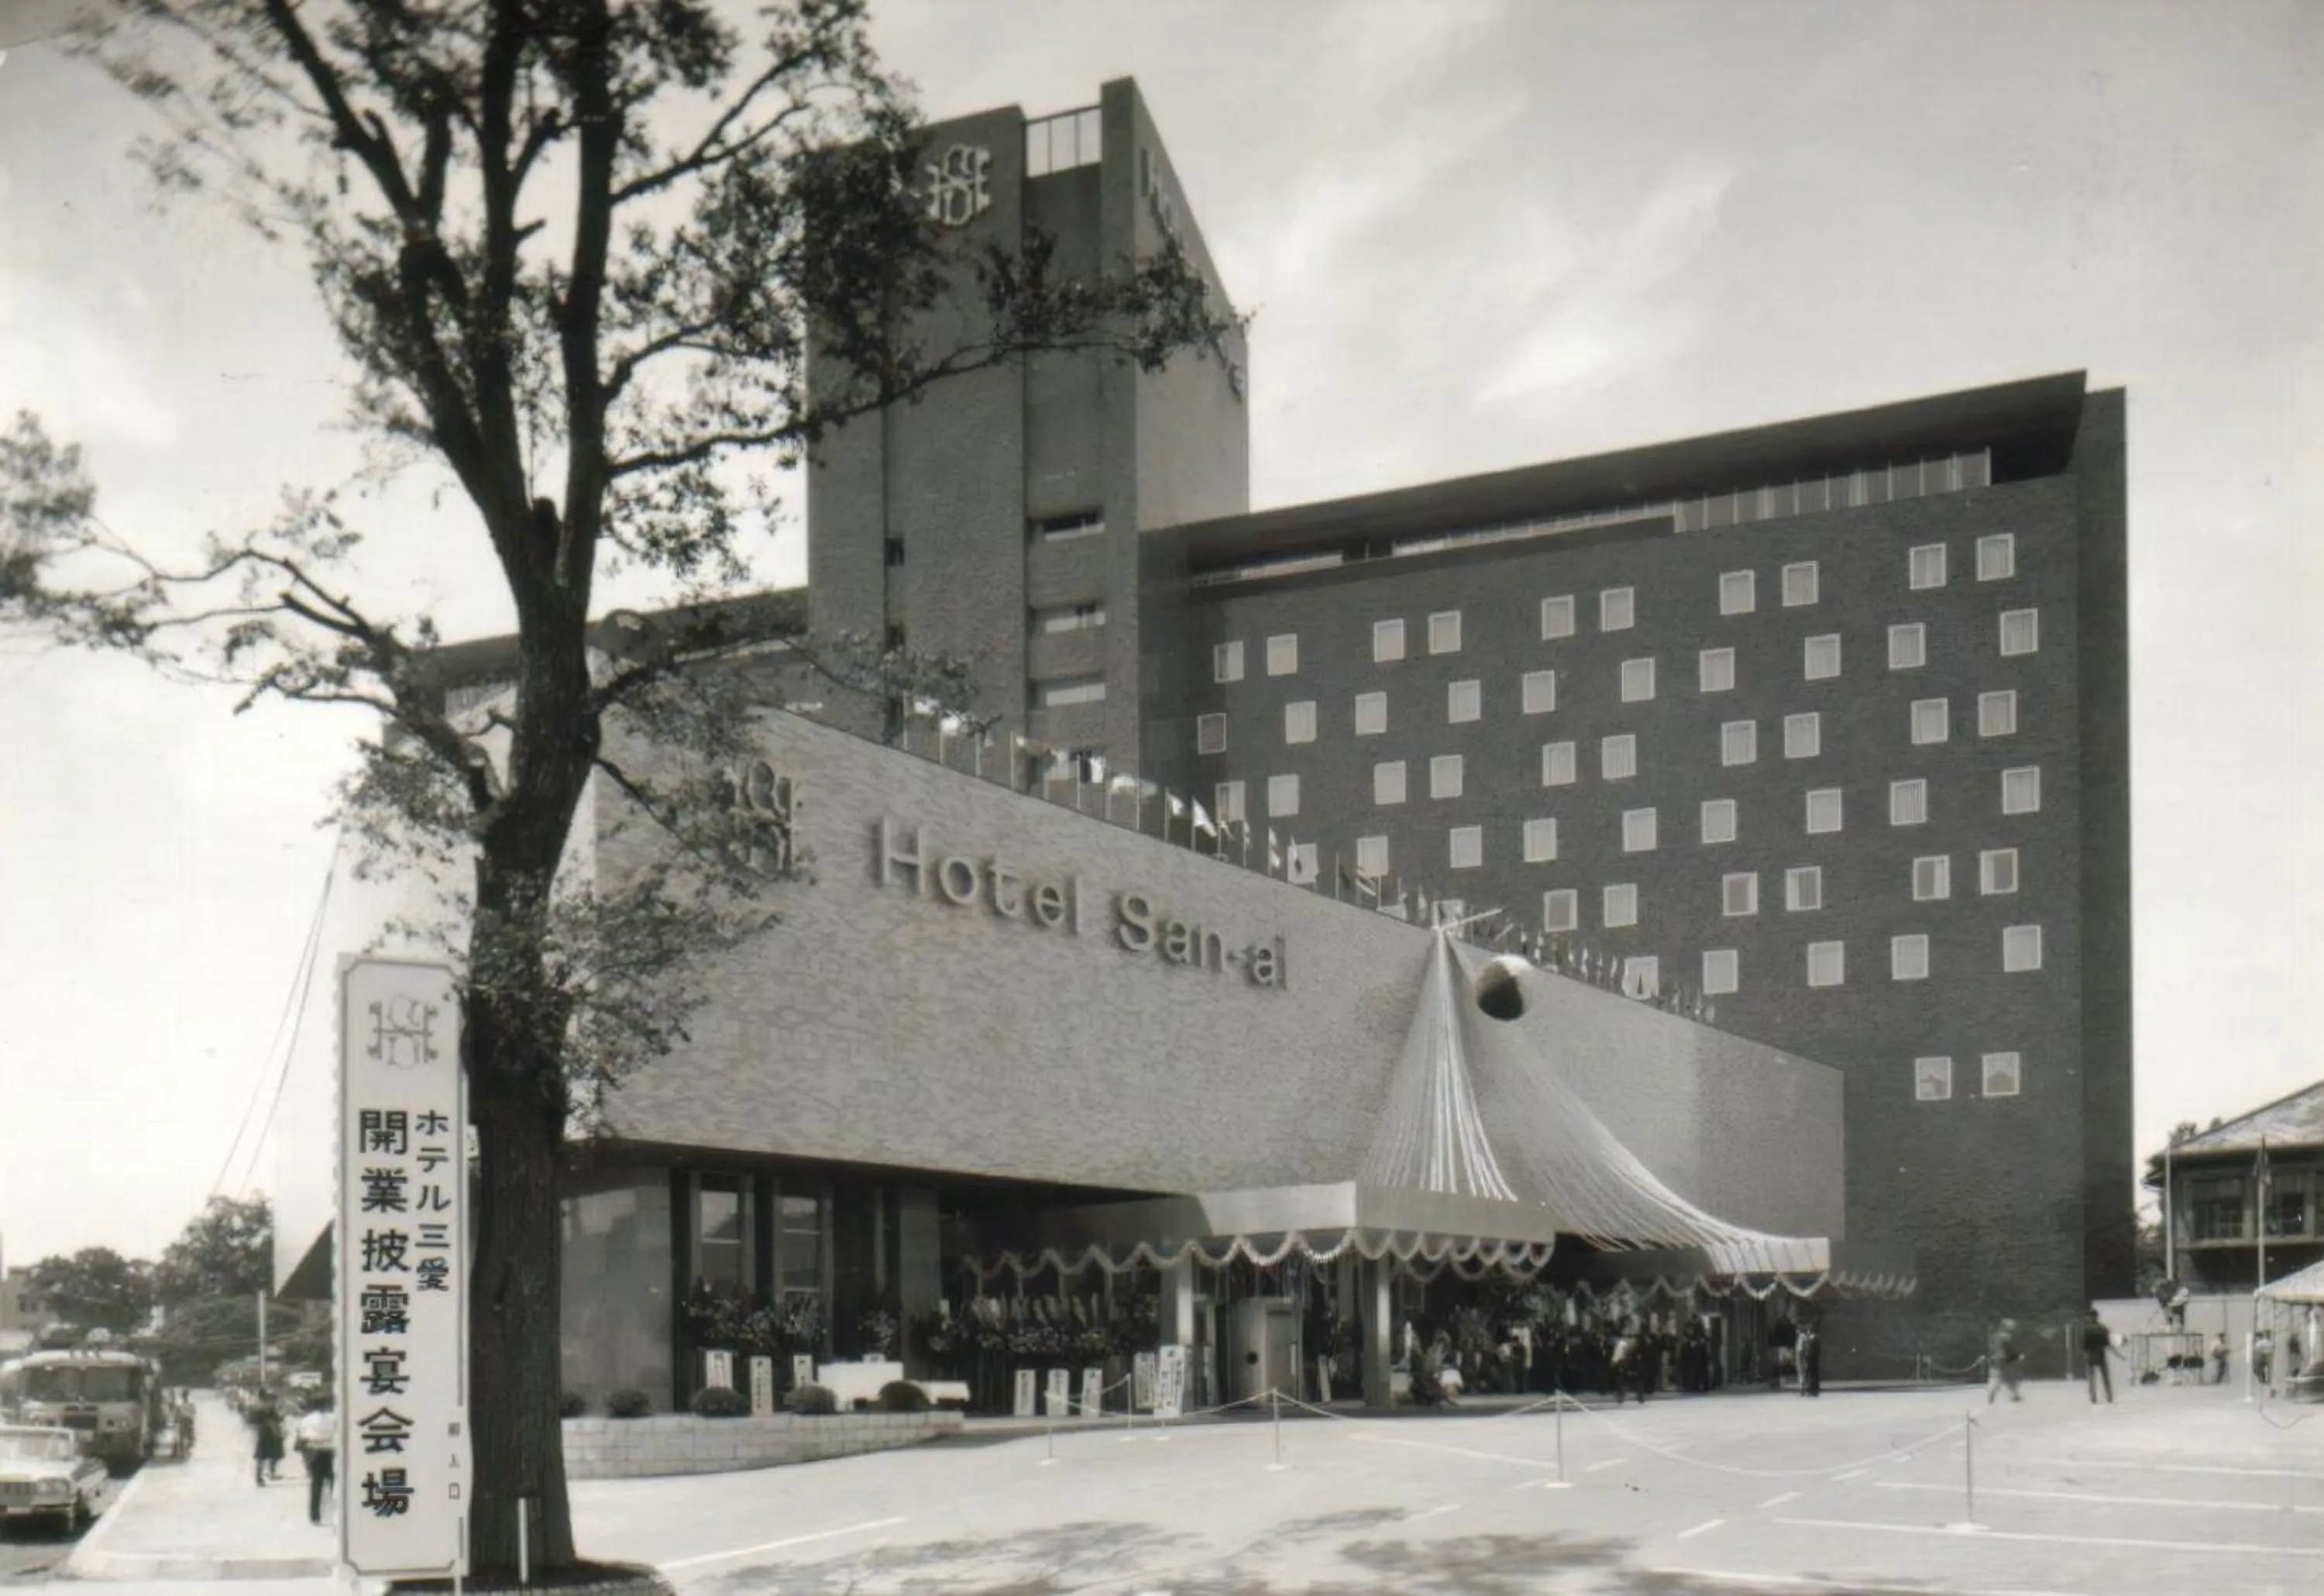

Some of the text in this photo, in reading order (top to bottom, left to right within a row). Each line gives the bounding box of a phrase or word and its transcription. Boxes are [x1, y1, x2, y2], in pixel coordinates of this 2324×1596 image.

[874, 814, 1082, 934] Hotel
[414, 1109, 452, 1292] ホテル三愛
[357, 1109, 414, 1518] 開業披露宴会場
